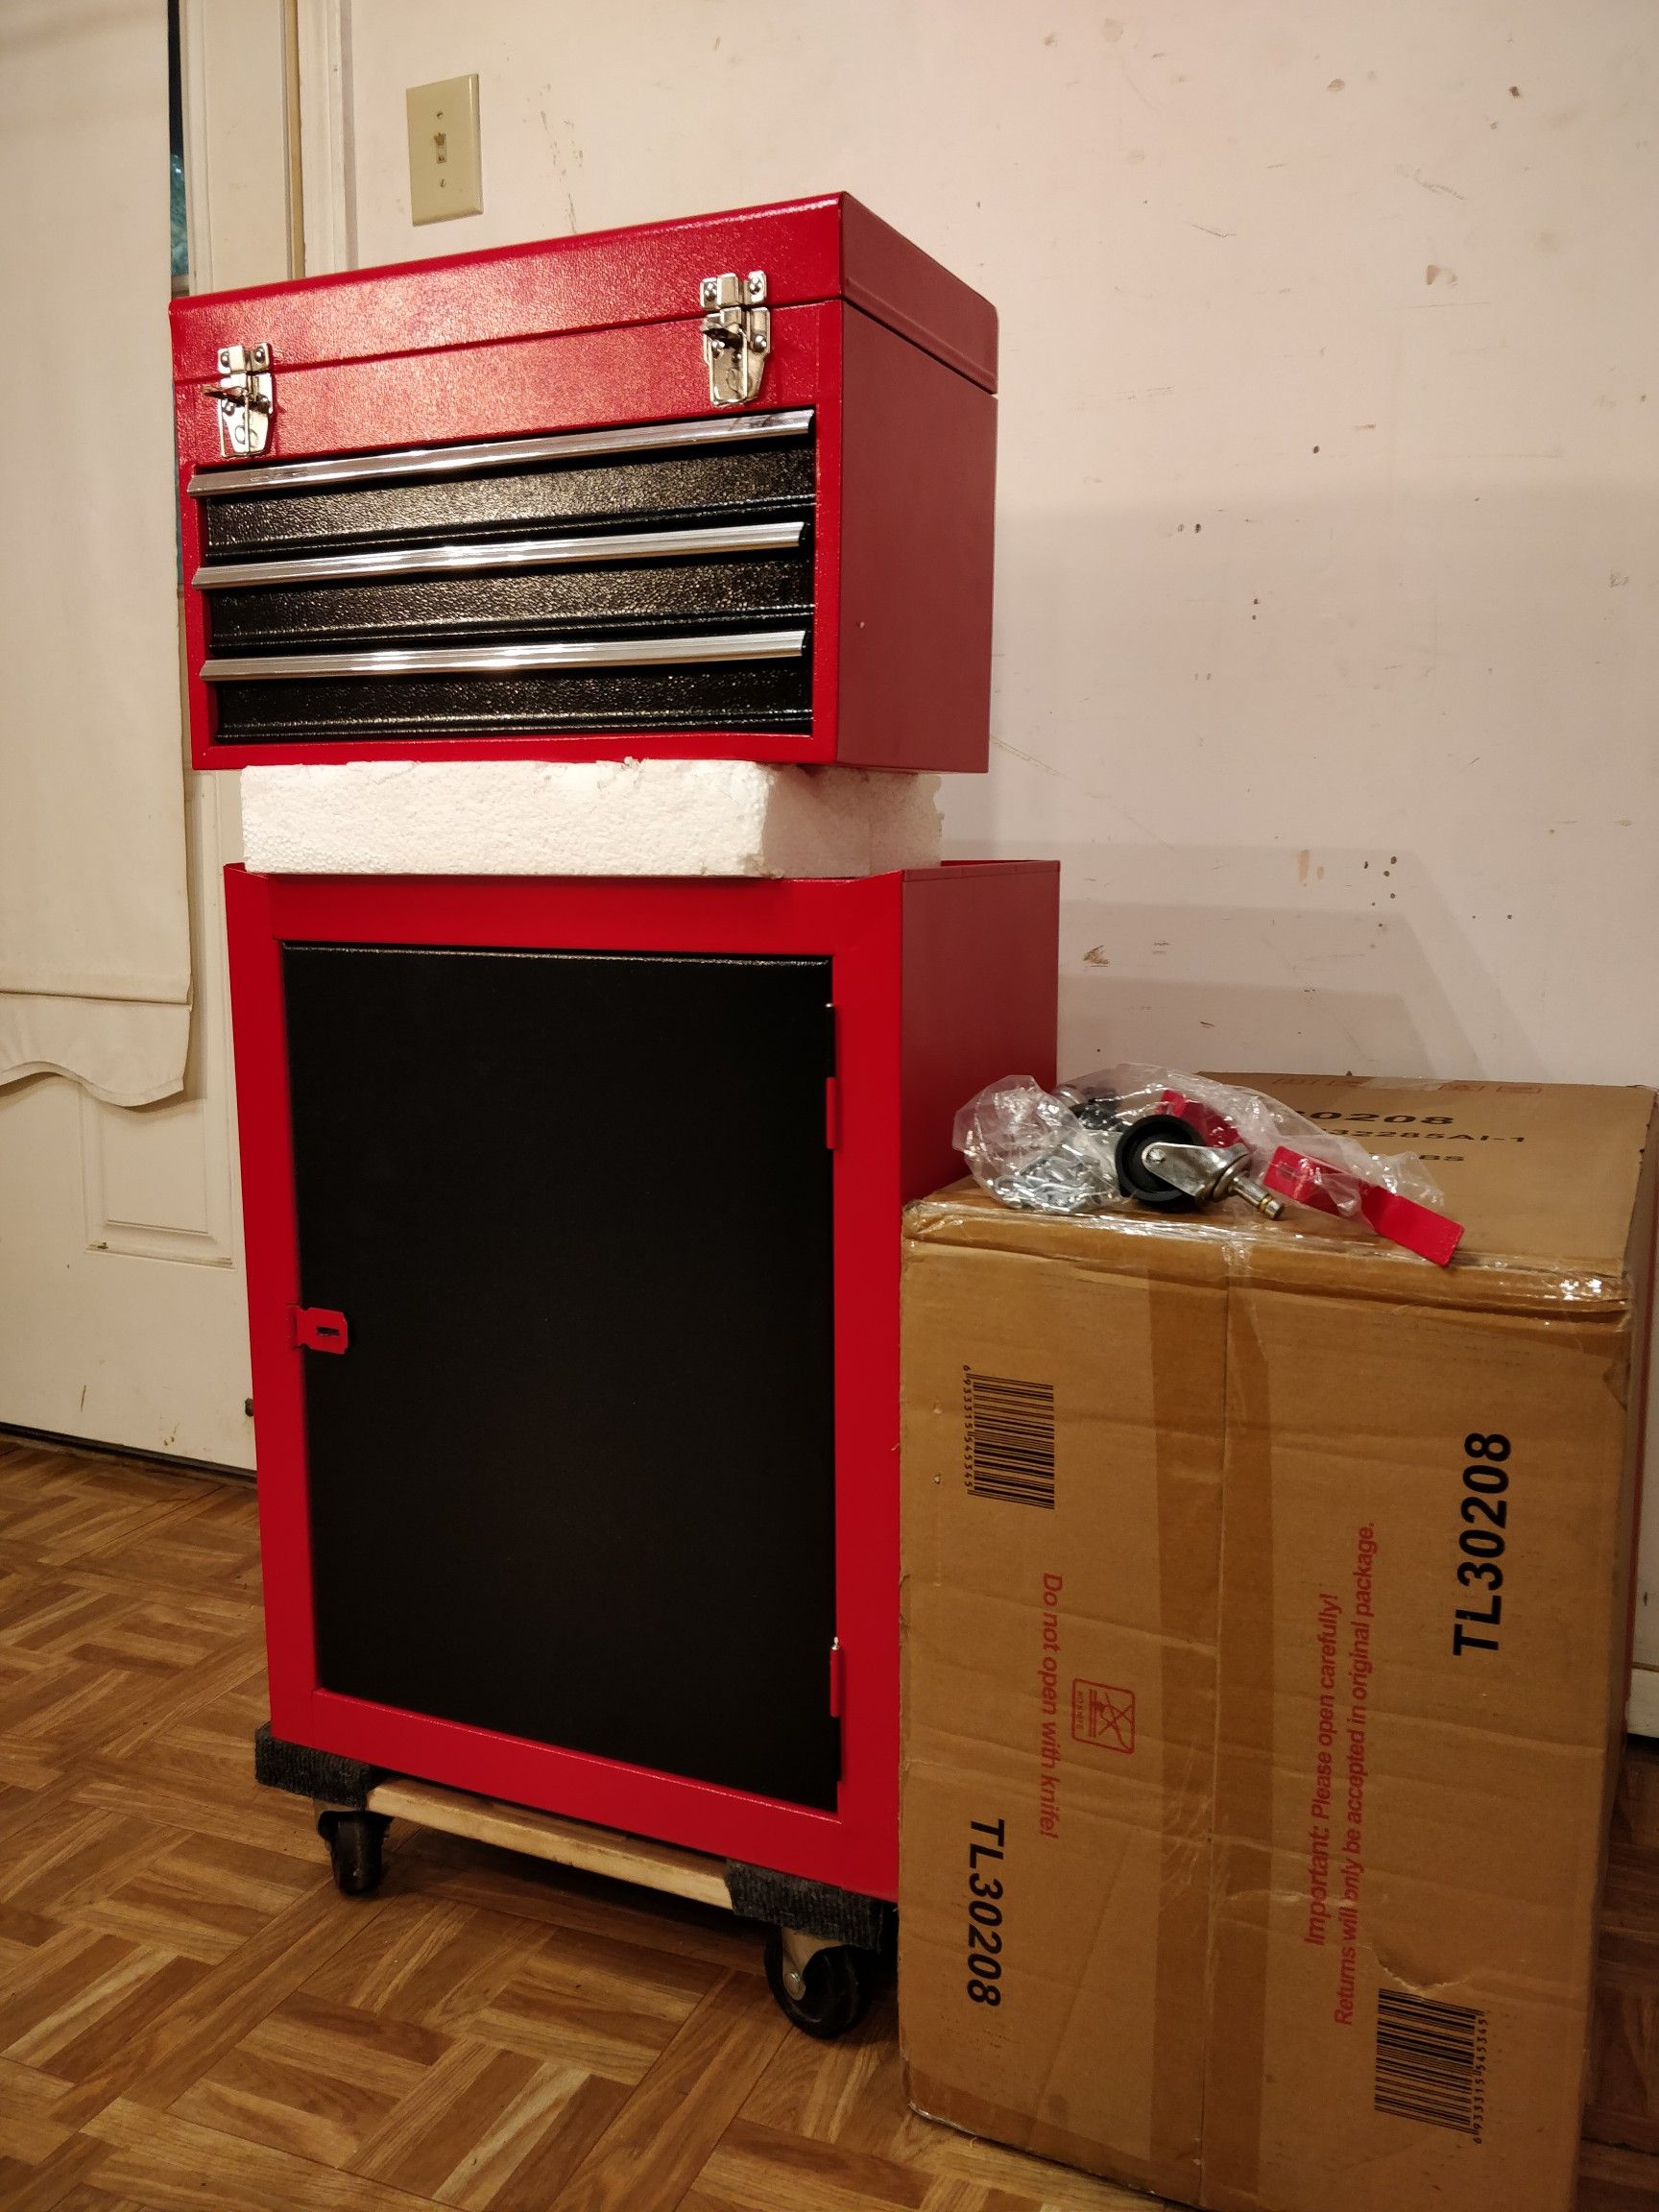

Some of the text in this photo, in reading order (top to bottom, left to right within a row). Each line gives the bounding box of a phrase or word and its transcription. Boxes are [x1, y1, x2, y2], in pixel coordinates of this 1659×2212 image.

[1295, 1111, 1455, 1125] 0208
[1453, 1432, 1512, 1656] TL30208
[1038, 1573, 1063, 1839] Do not open with knife!
[1304, 1593, 1343, 1946] Important: Please open carefully!
[1334, 1522, 1379, 2027] Returns will only be accepted in original package.
[967, 1817, 1005, 2007] TL30208
